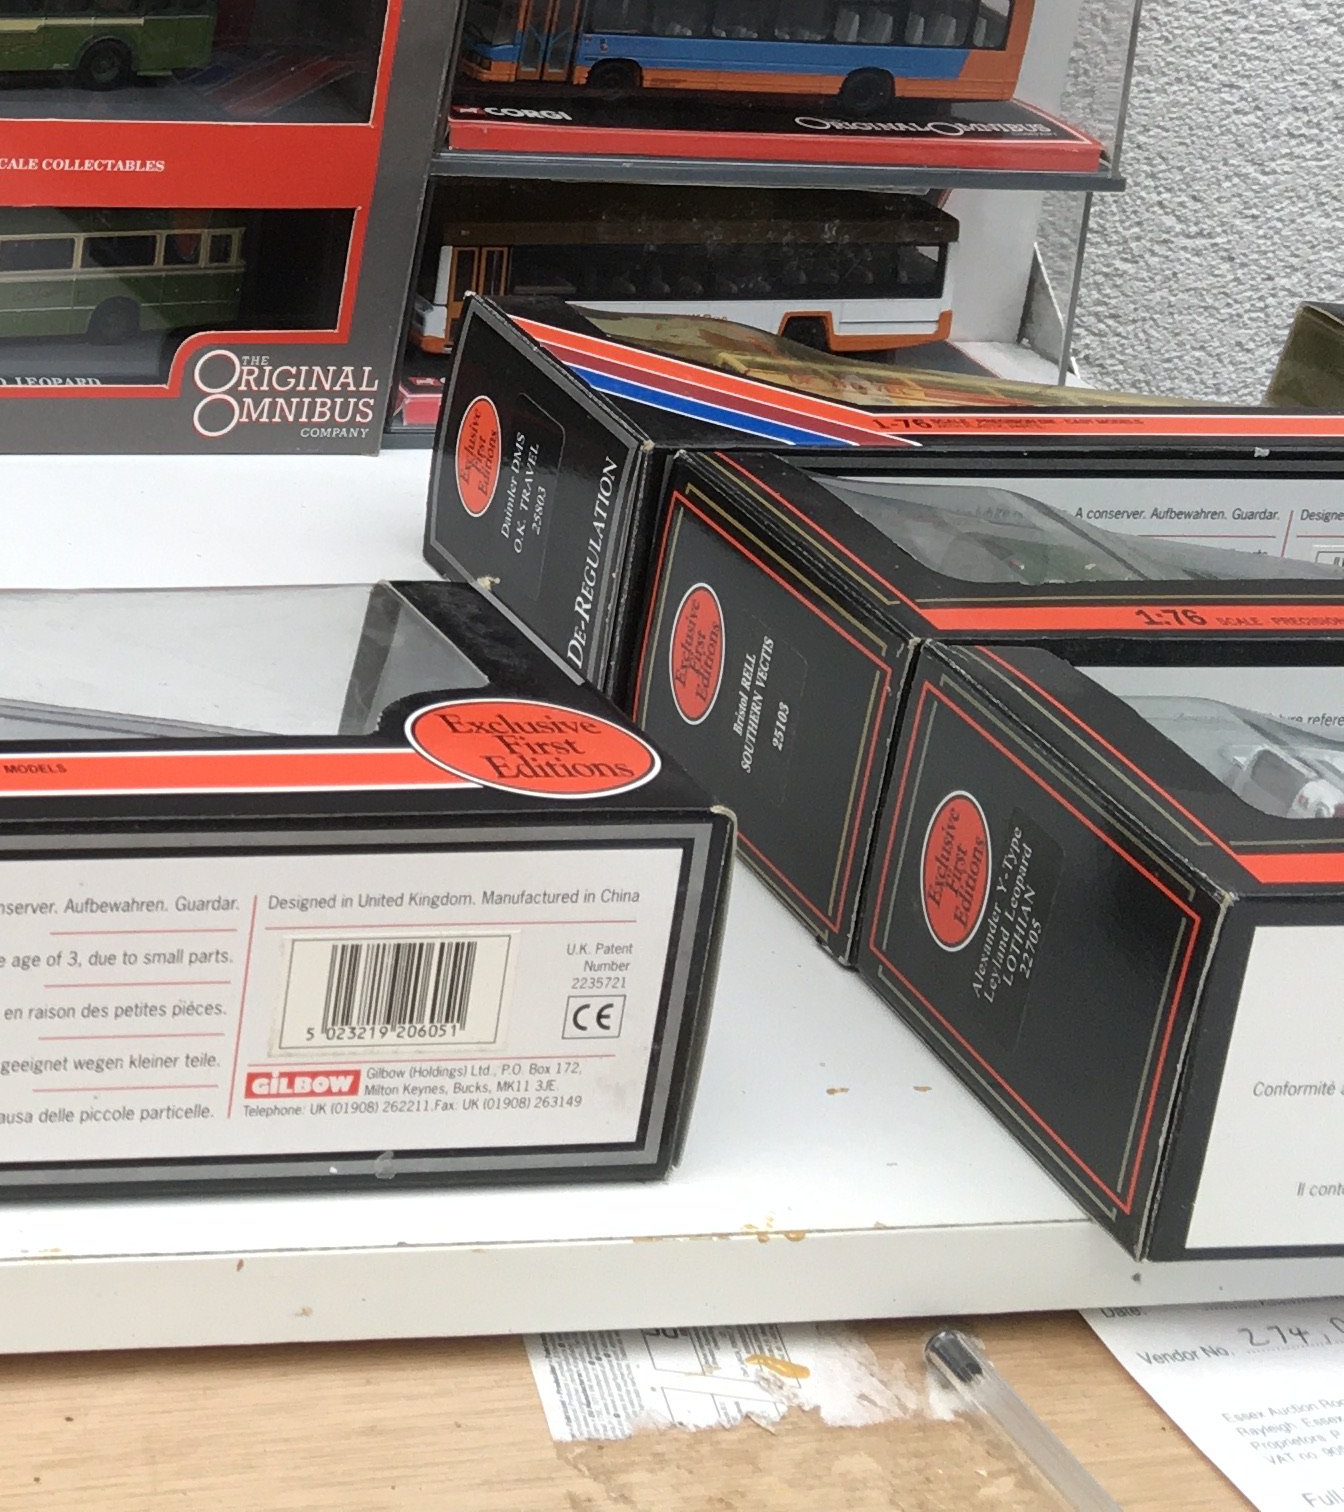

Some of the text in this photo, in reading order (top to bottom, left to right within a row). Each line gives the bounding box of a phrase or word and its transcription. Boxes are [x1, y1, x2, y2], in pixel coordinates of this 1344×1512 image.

[484, 107, 572, 121] CORGI
[43, 159, 164, 173] COLLECTABLES
[194, 350, 378, 392] ORIGINAL
[242, 356, 270, 366] THE
[193, 392, 374, 437] OMNIBUS
[300, 428, 368, 438] COMPANY
[674, 598, 701, 686] Exclusive
[689, 630, 707, 678] First
[695, 620, 720, 702] Editions
[733, 652, 756, 737] Bristol RELL
[740, 635, 774, 773] SOUTHERN VECTIS
[439, 714, 602, 737] Exclusive
[492, 735, 585, 757] First
[773, 704, 790, 751] 25103
[480, 755, 634, 781] Editions
[927, 806, 961, 908] Exclusive
[946, 845, 968, 896] First
[64, 898, 168, 914] Aufbewahren.
[175, 895, 239, 912] Guardar.
[267, 889, 640, 912] Designed in United Kingdom. Manufactured in China
[954, 837, 985, 929] Editions
[972, 826, 1022, 998] Alexander Y-Type
[984, 843, 1033, 1003] Leyland Leopard
[1002, 885, 1036, 987] LOTHIAN
[1020, 919, 1042, 979] 22705
[1138, 1344, 1232, 1367] Vendor No.
